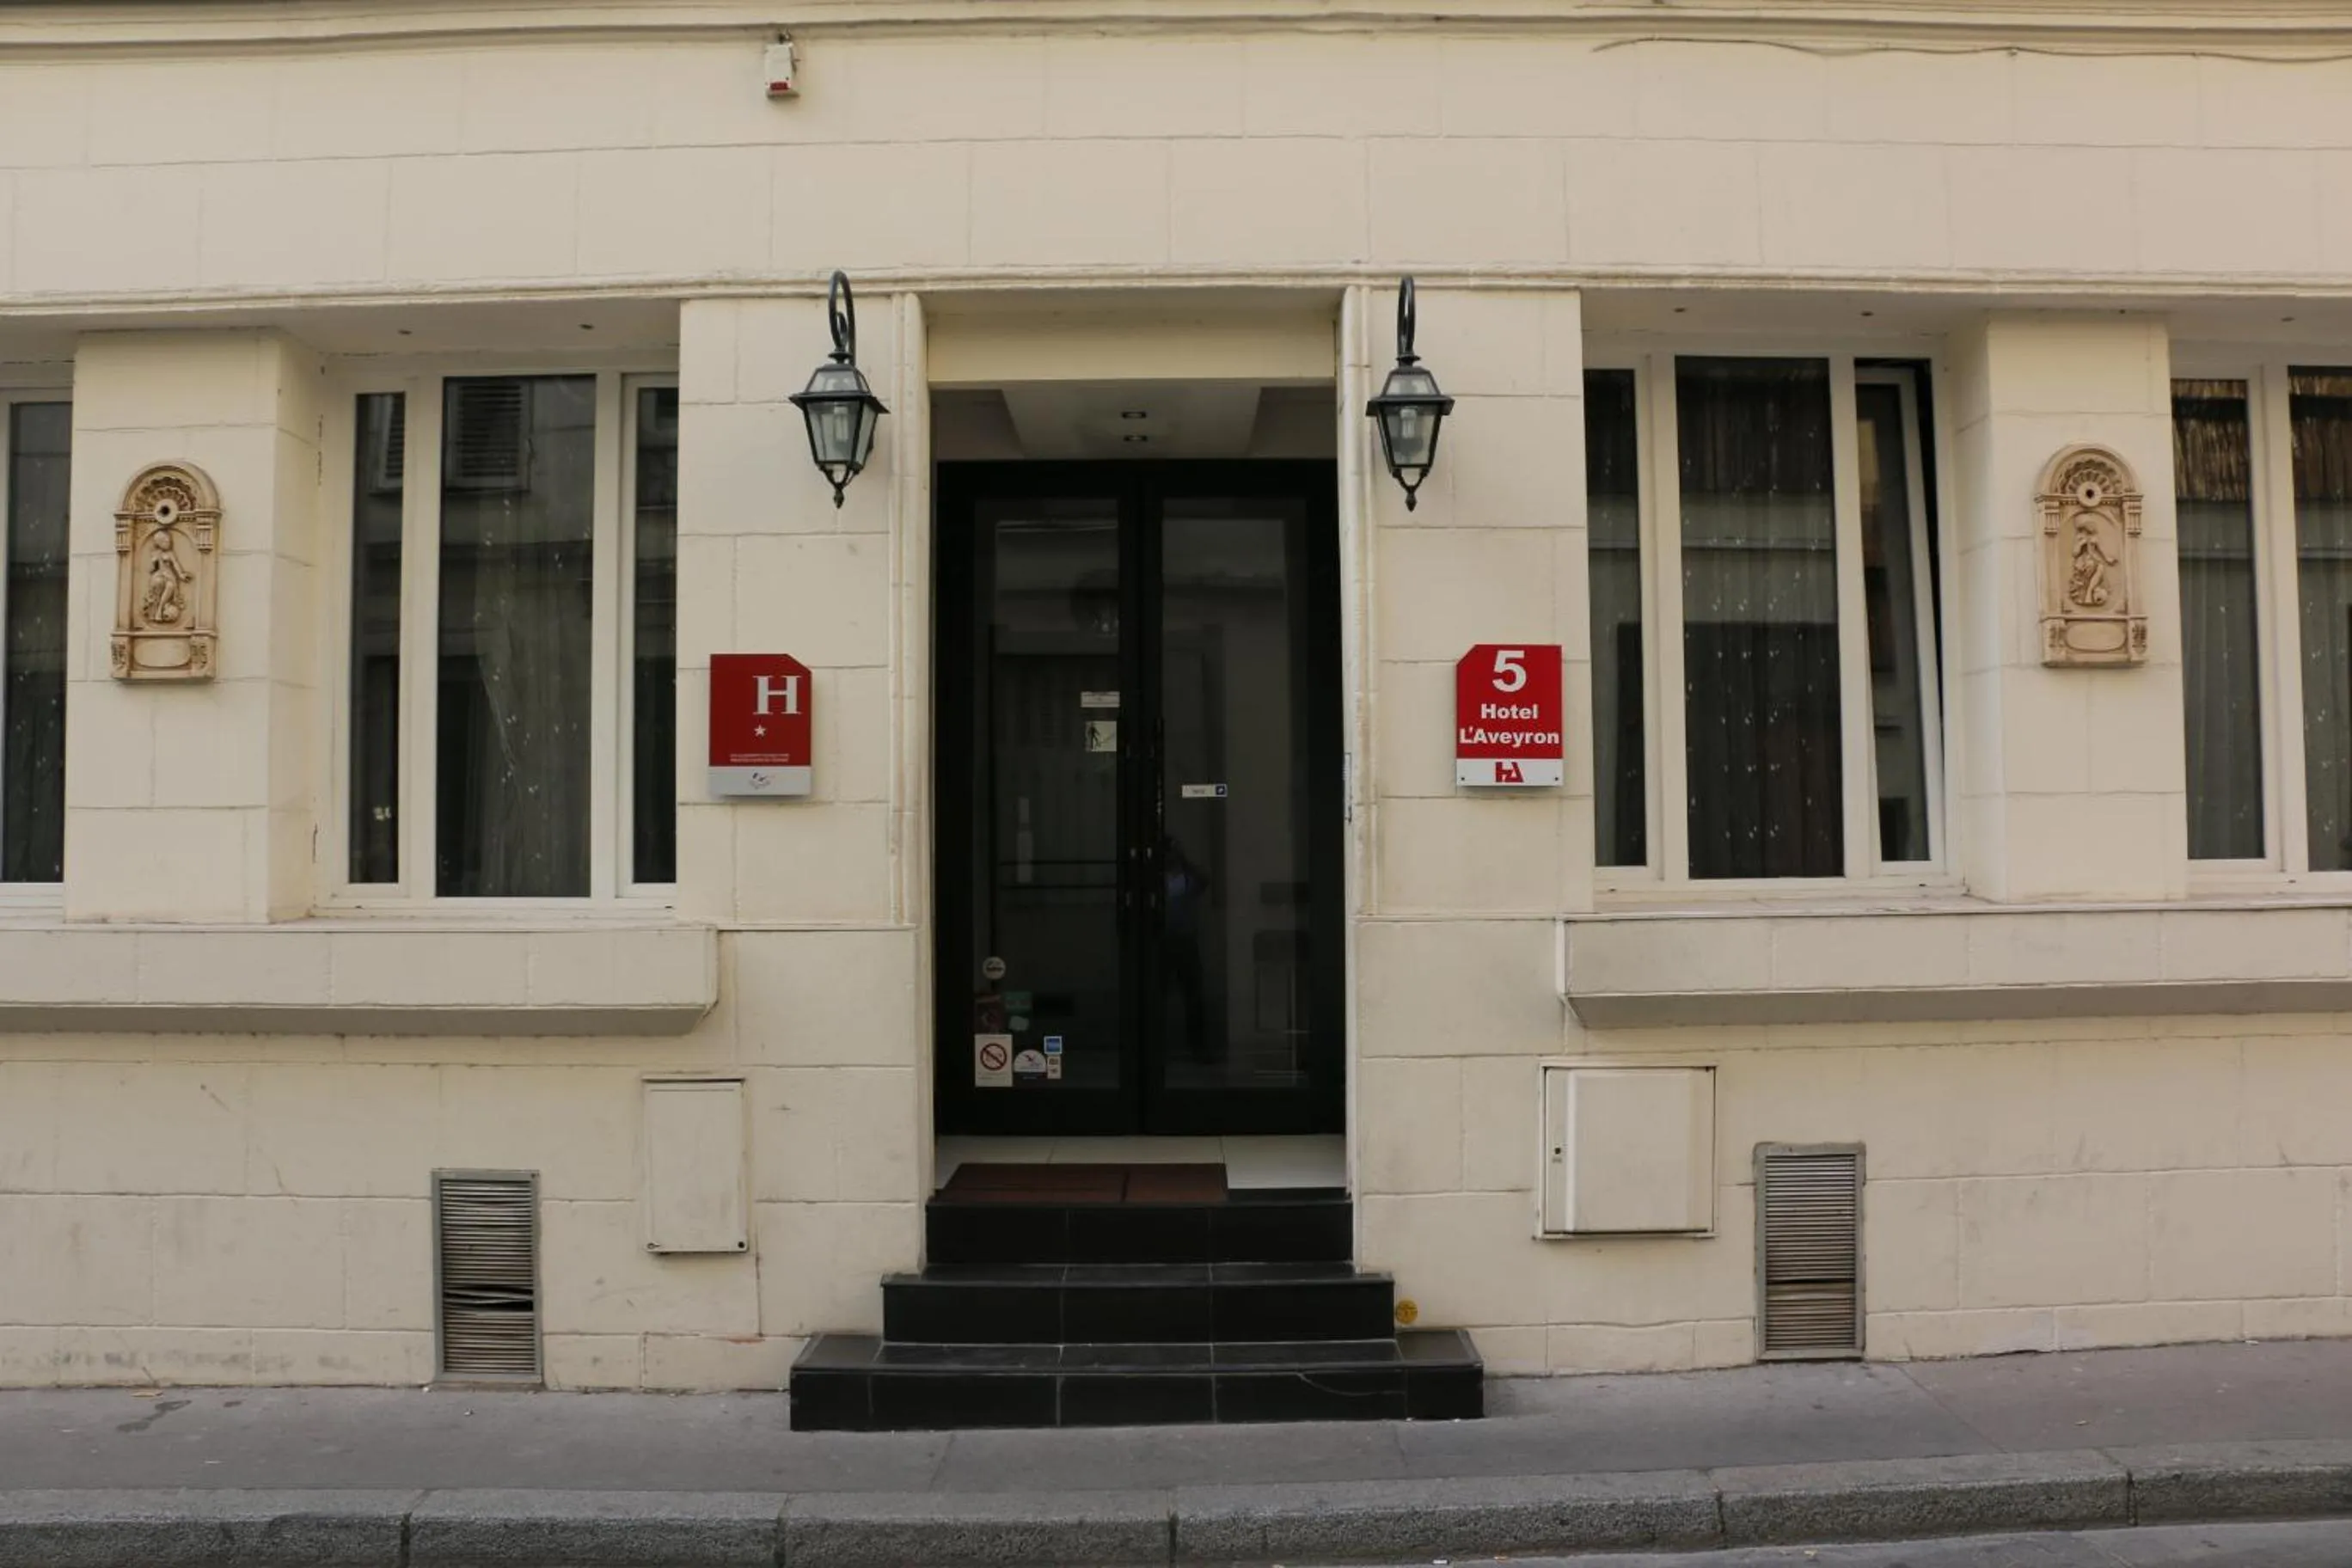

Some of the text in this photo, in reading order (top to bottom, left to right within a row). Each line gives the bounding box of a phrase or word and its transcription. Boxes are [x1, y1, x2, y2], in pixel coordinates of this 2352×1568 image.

[1492, 650, 1527, 692] 5
[752, 675, 802, 714] H
[1480, 703, 1539, 720] Hotel
[1460, 726, 1560, 748] L'Aveyron
